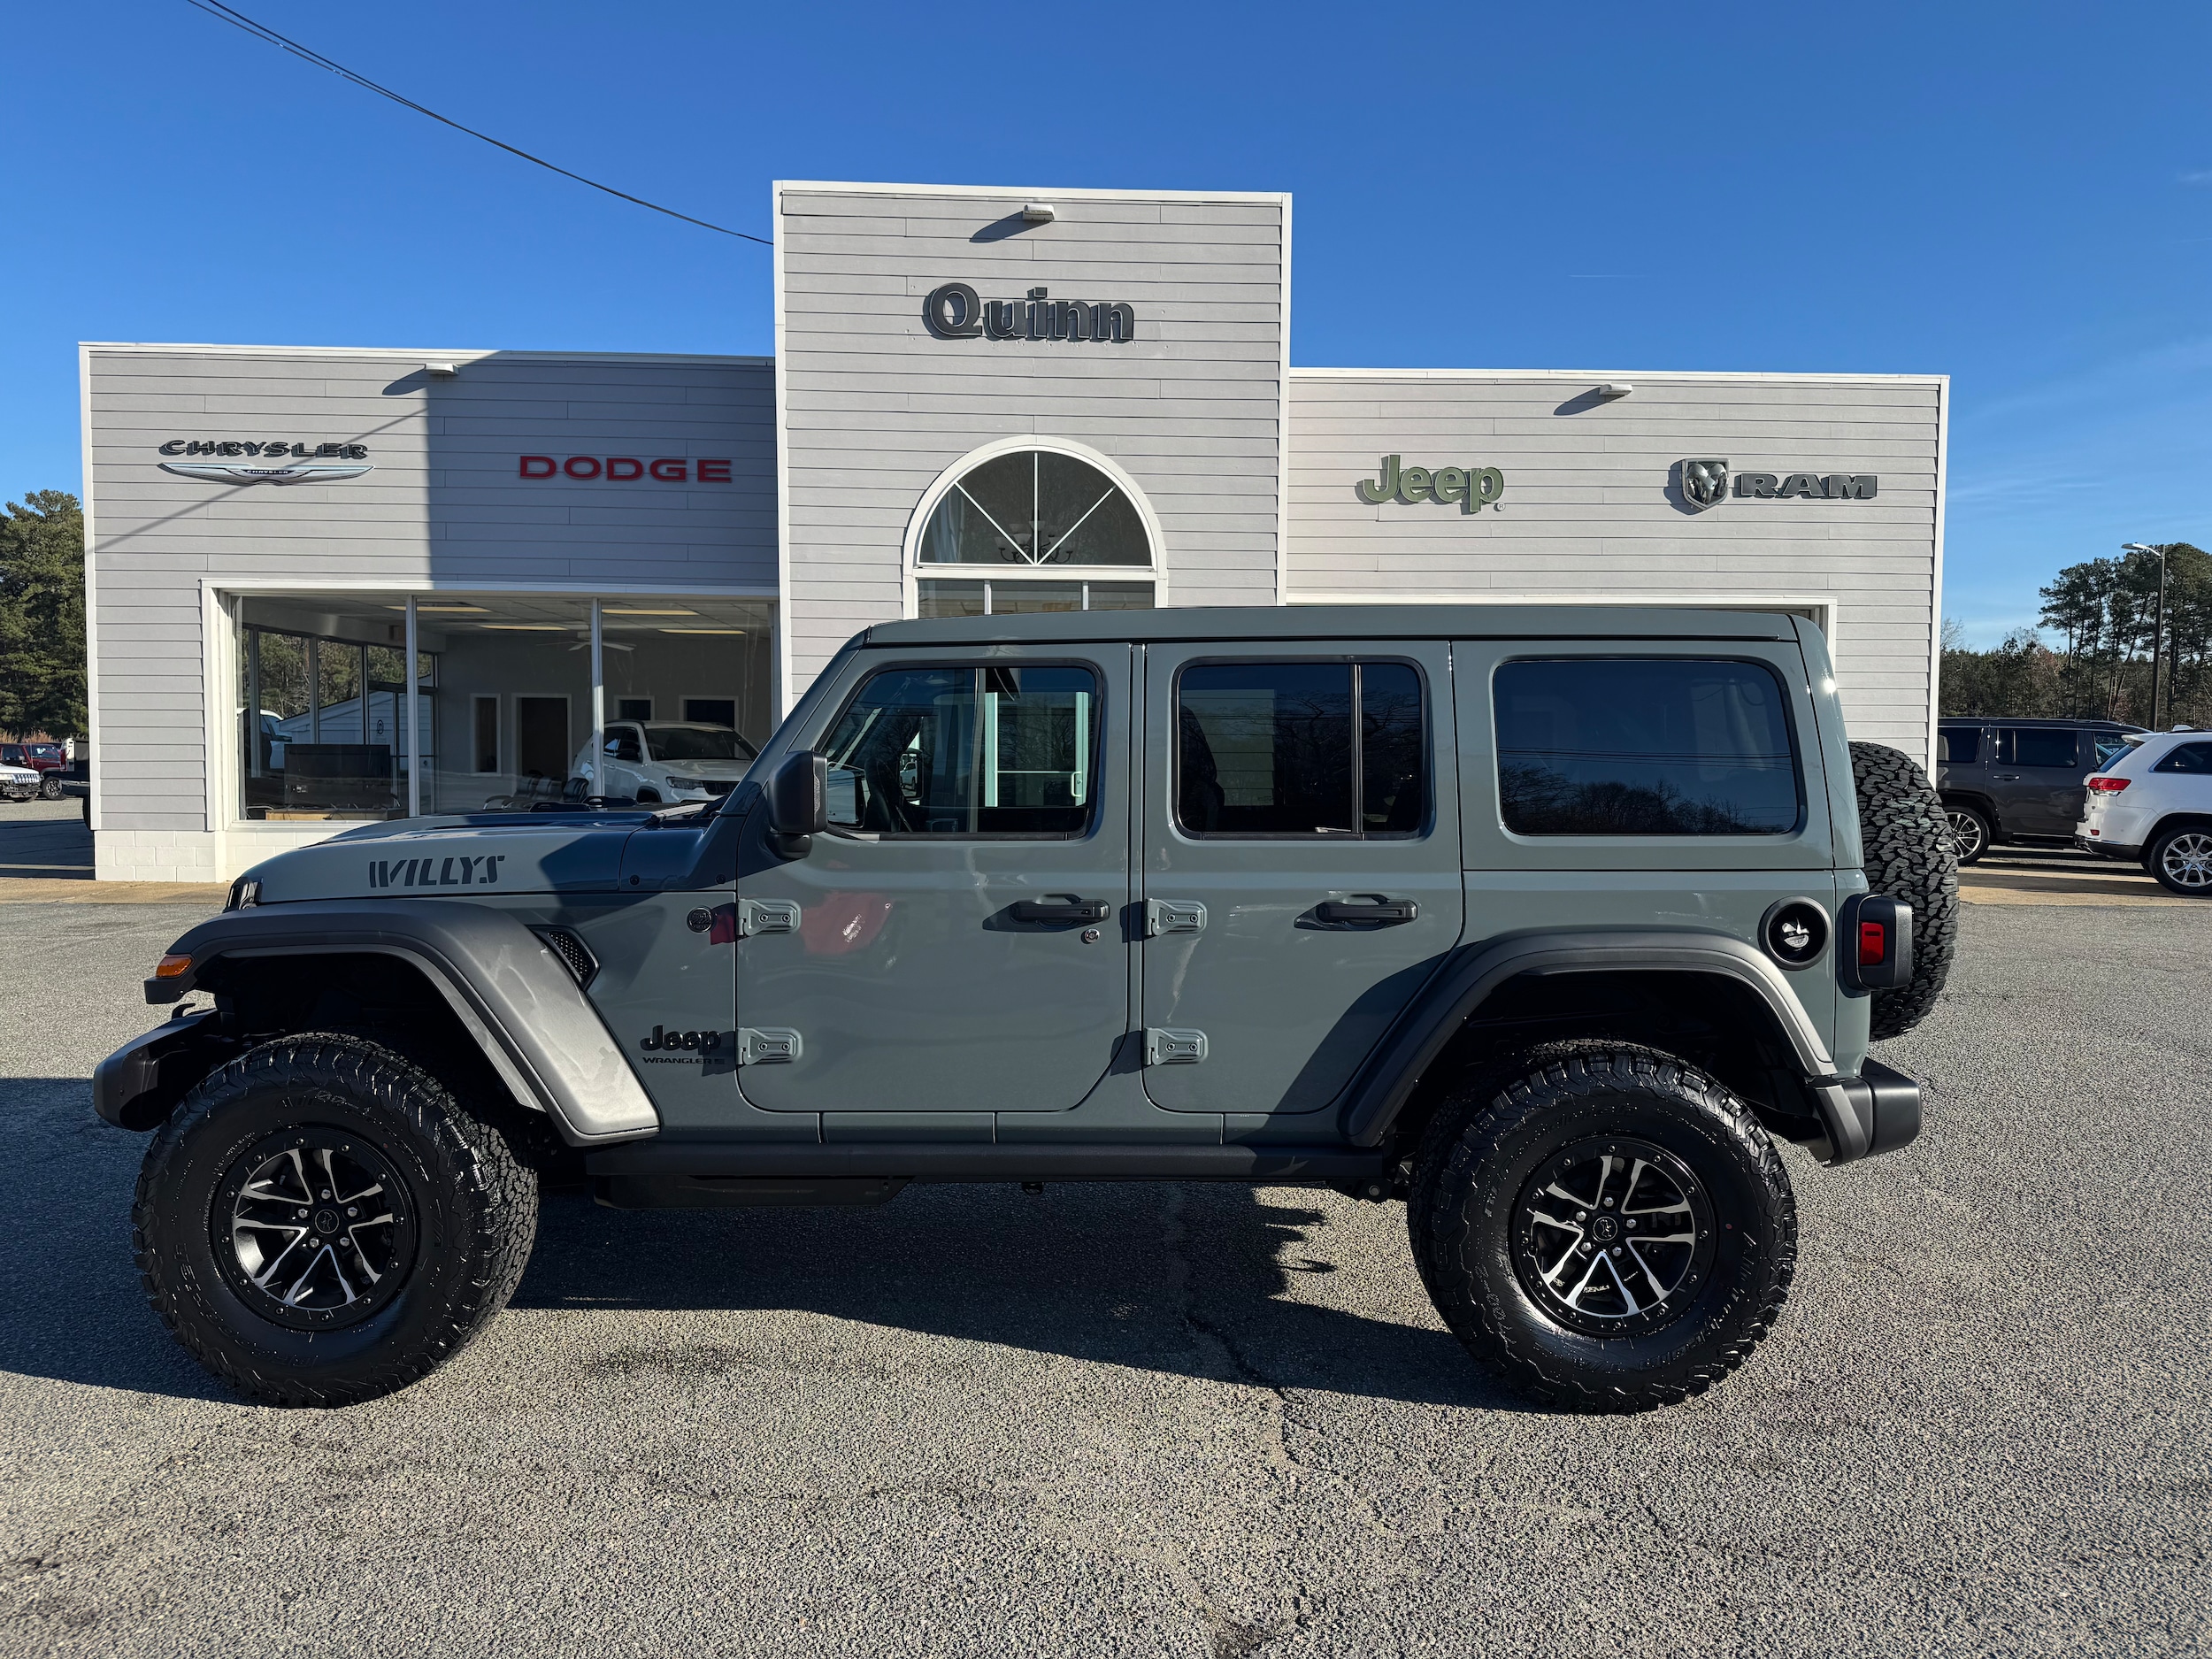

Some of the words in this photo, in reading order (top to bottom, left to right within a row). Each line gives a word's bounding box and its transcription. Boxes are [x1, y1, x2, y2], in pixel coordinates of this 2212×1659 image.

[927, 282, 1135, 342] Quinn
[161, 440, 368, 459] CHRYSLER
[519, 456, 733, 483] DODGE
[1361, 454, 1505, 513] Jeep
[1738, 472, 1878, 498] RAM
[369, 855, 506, 888] WILLYS
[641, 1025, 721, 1056] Jeep
